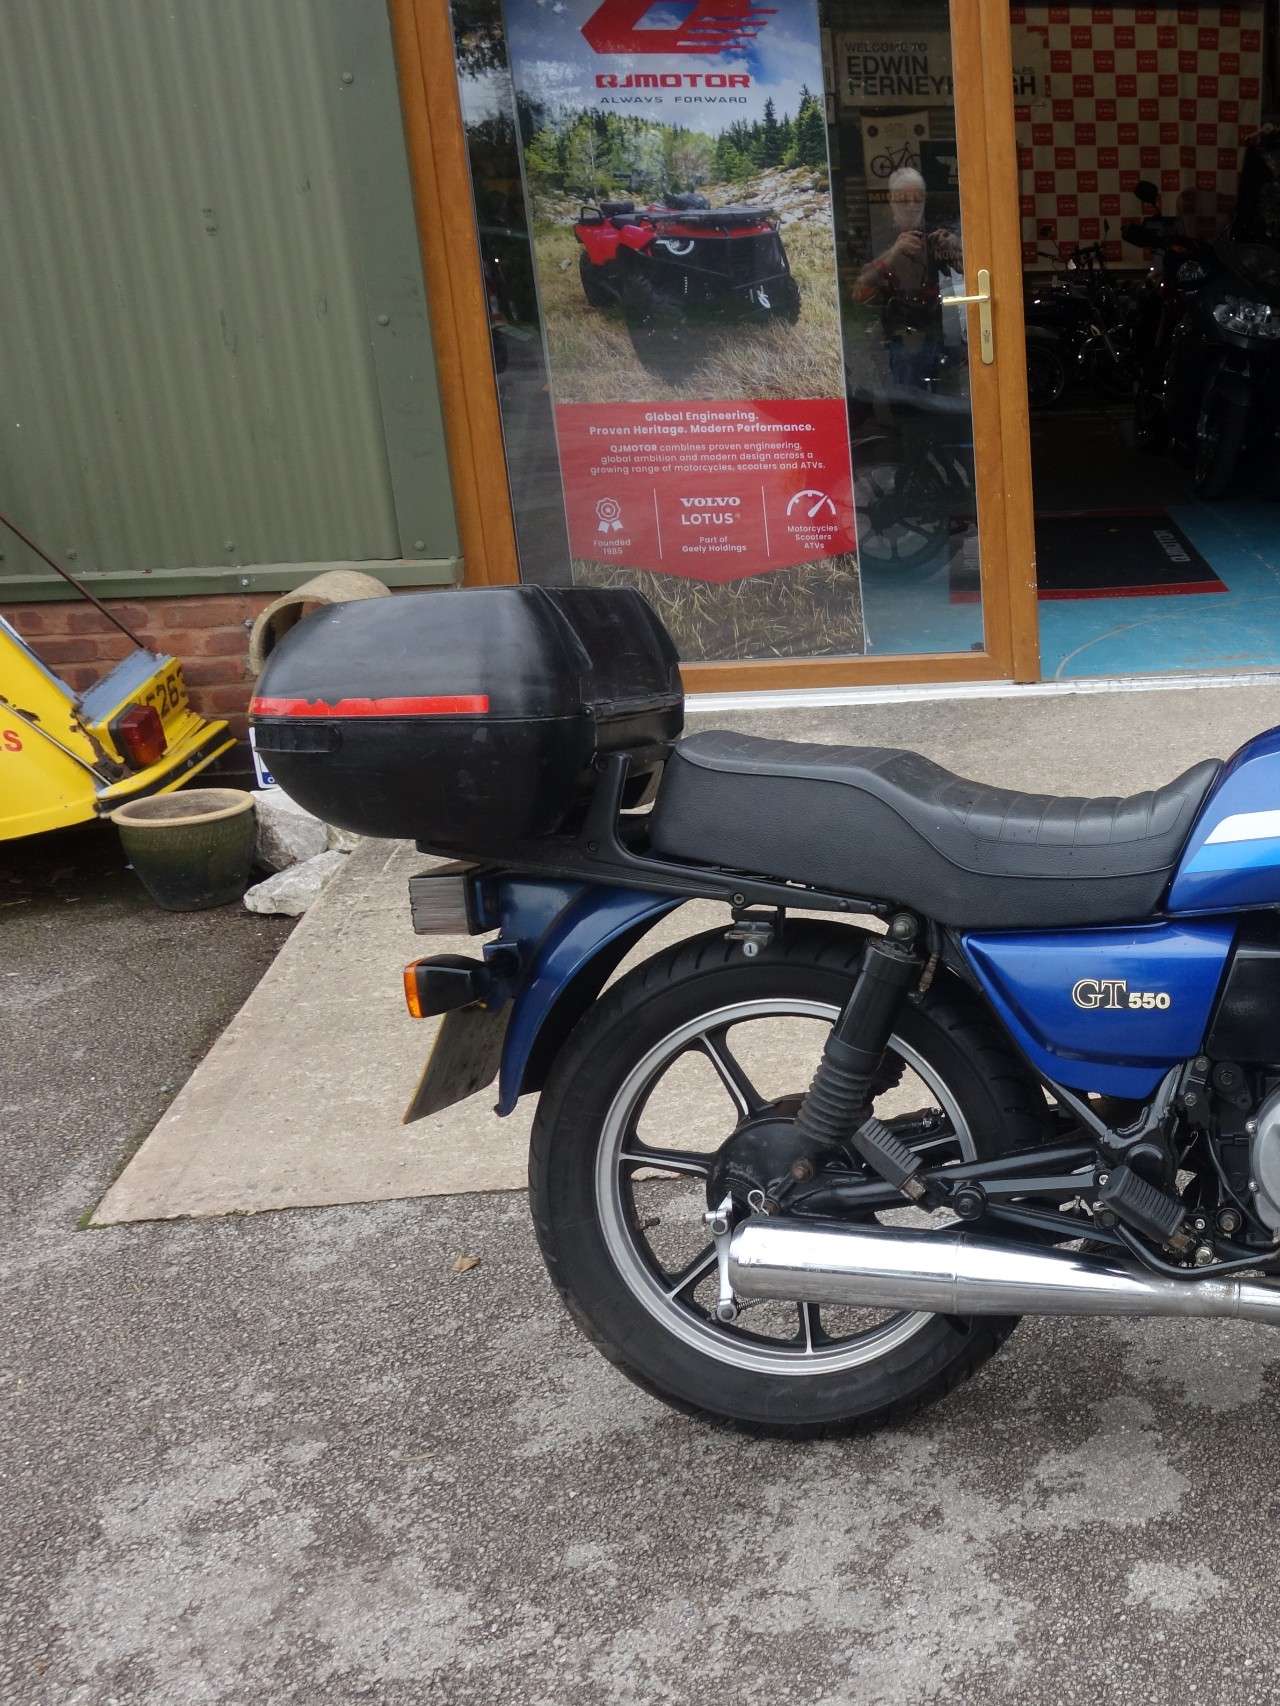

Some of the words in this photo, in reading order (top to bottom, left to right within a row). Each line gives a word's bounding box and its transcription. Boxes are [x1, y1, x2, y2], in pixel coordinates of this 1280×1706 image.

[847, 56, 928, 75] EDWIN
[595, 73, 750, 89] QJMOTOR
[601, 96, 664, 104] ALWAYS
[674, 96, 748, 104] FORWARD
[645, 412, 683, 422] Global
[686, 410, 759, 423] Engineering.
[589, 426, 631, 436] Proven
[633, 425, 688, 436] Heritage.
[690, 424, 735, 433] Modern
[737, 422, 816, 433] Performance.
[610, 444, 657, 453] QJMOTOR
[659, 443, 706, 451] combines
[709, 442, 742, 451] proven
[601, 456, 631, 464] global
[633, 454, 677, 462] ambition
[700, 452, 737, 460] modern
[739, 451, 771, 461] design
[773, 451, 805, 459] across
[590, 466, 629, 476] growing
[631, 466, 660, 474] range
[737, 462, 777, 470] scooters
[779, 461, 799, 470] and
[680, 497, 741, 507] VOLVO
[681, 513, 734, 525] LOTUS
[787, 524, 839, 534] Motorcycles
[593, 538, 632, 546] Founded
[699, 536, 721, 544] Part
[804, 541, 825, 550] ATVs
[682, 545, 708, 554] Geely
[708, 544, 747, 554] Holdings
[1072, 979, 1127, 1009] GT
[1128, 992, 1171, 1009] 550
